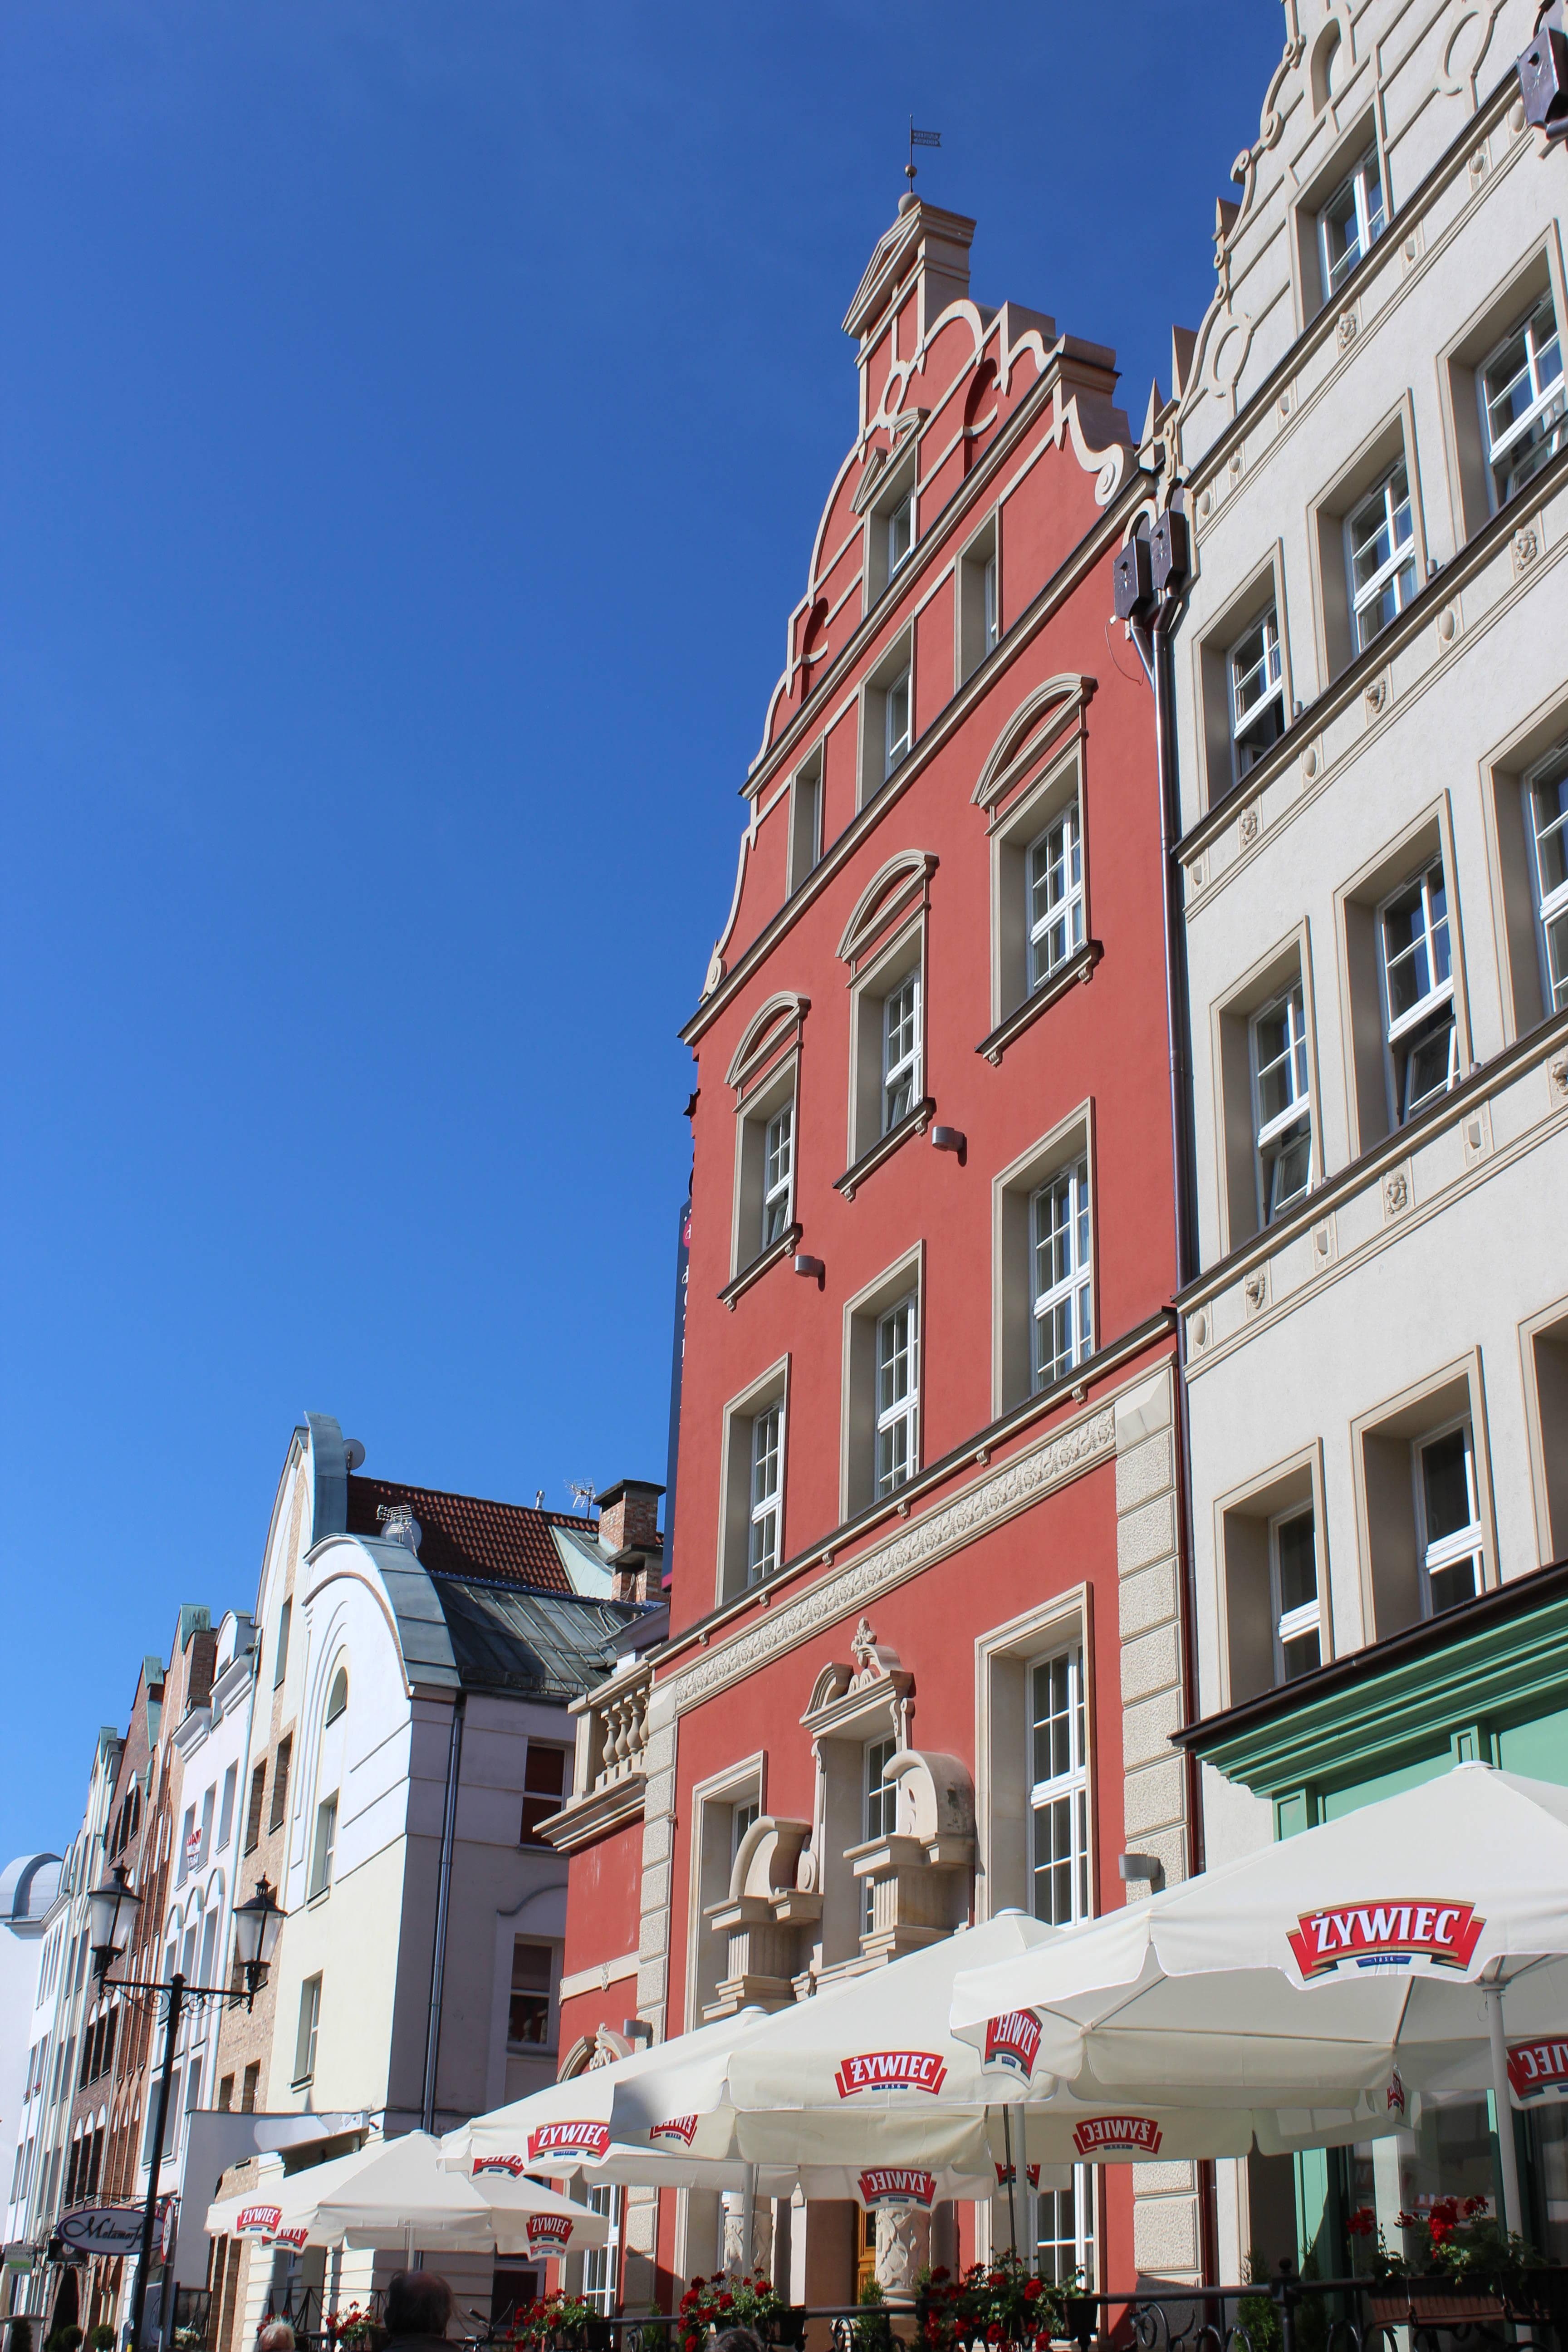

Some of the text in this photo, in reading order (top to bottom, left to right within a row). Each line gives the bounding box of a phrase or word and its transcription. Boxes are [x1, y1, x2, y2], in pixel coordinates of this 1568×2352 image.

[1311, 1907, 1460, 1953] ŻYWIEC
[850, 2055, 935, 2083] ŻYWIEC
[538, 2124, 608, 2147] ŻYWIEC
[242, 2208, 279, 2224] ŻYWIEC
[532, 2216, 568, 2234] ŻYWIEC
